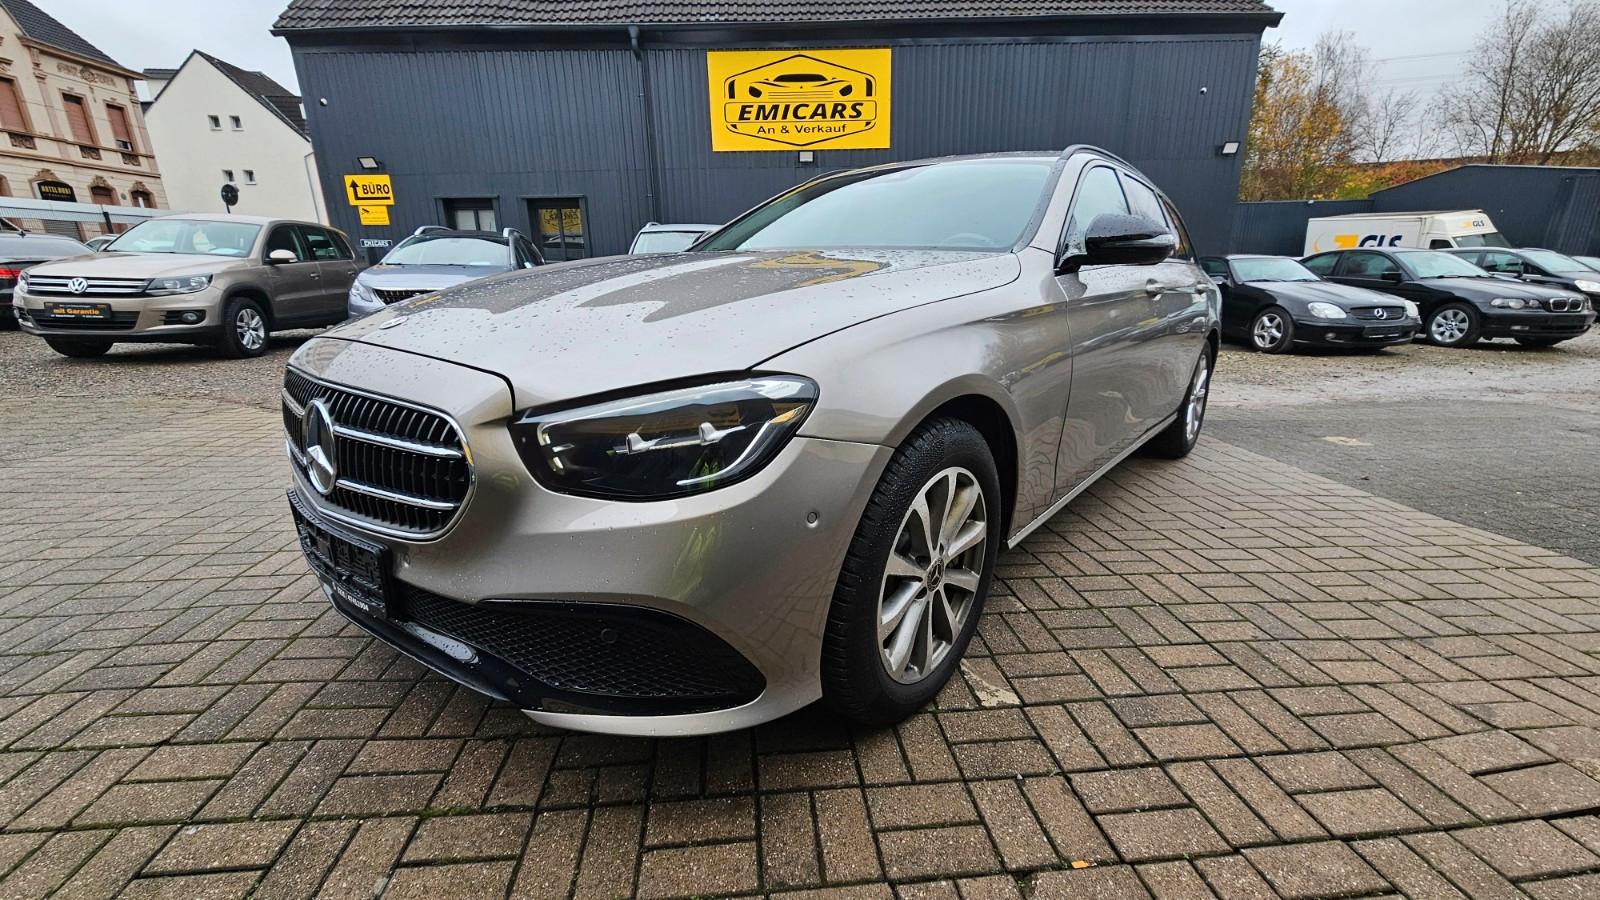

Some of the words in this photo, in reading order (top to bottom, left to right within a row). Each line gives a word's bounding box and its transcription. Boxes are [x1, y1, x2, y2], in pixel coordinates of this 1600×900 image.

[738, 102, 864, 121] EMICARS
[757, 125, 775, 134] An
[780, 125, 790, 134] &
[795, 124, 847, 134] Verkauf
[362, 182, 390, 194] BÜRO
